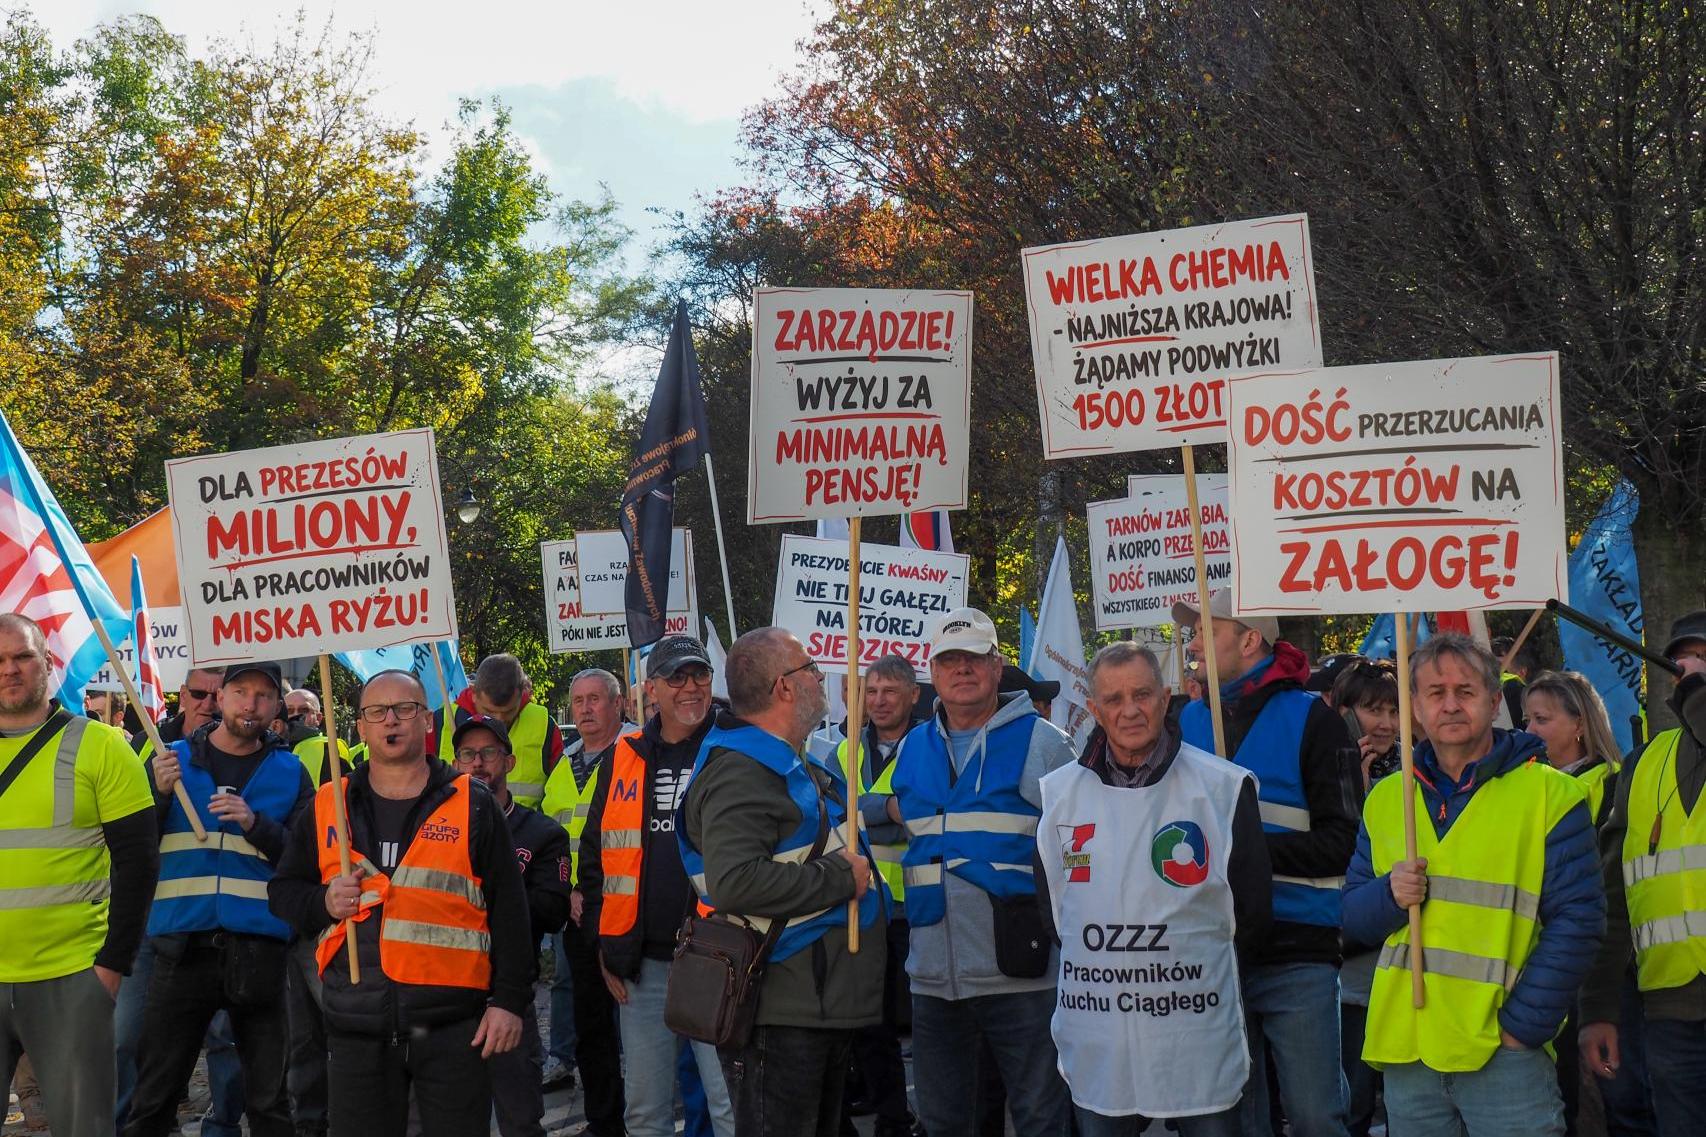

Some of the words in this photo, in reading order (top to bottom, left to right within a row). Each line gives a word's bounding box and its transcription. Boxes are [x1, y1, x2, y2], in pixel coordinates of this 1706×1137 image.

[1046, 256, 1162, 305] WIELKA
[1169, 241, 1290, 292] CHEMIA
[775, 309, 954, 363] ZARZĄDZIE!
[1067, 303, 1180, 343] NAJNIŻSZA
[1184, 291, 1292, 330] KRAJOWA!
[1073, 351, 1161, 389] ŻĄDAMY
[1169, 332, 1280, 375] PODWYŻKI
[796, 367, 889, 411] WYŻYJ
[897, 375, 932, 409] ZA
[1072, 388, 1145, 431] 1500
[1154, 379, 1225, 422] ZŁOT
[1245, 387, 1352, 446] DOŚĆ
[1358, 403, 1544, 438] PRZERZUCANIA
[776, 424, 947, 465] MINIMALNĄ
[198, 471, 253, 503] DLA
[259, 447, 407, 497] PREZESÓW
[805, 463, 921, 507] PENSJĘ!
[1274, 455, 1459, 511] KOSZTÓW
[1472, 468, 1520, 501] NA
[207, 490, 417, 560] MILIONY,
[1106, 507, 1163, 537] TARNÓW
[1166, 503, 1229, 529] ZARBIA,
[1107, 544, 1116, 562] A
[1119, 538, 1160, 560] KORPO
[1279, 530, 1519, 600] ZAŁOGĘ!
[202, 578, 248, 604] DLA
[255, 552, 430, 598] PRACOWNIKÓW
[585, 574, 608, 582] CZAS
[611, 573, 625, 581] NA
[796, 579, 828, 598] NIE
[887, 563, 949, 584] KWAŚNY
[1108, 564, 1145, 593] DOŚĆ
[1148, 561, 1231, 587] FINANSOANIA
[213, 603, 322, 646] MISKA
[329, 587, 428, 634] RYŻU!
[816, 609, 844, 629] NA
[859, 611, 923, 638] TÓREJ
[1102, 597, 1160, 614] WSZYSTKIEGO
[1170, 592, 1200, 606] NASZE
[562, 624, 584, 641] PÓKI
[586, 626, 602, 639] NIE
[605, 624, 626, 638] JEST
[613, 779, 637, 801] NA
[1083, 923, 1169, 952] OZZZ
[1063, 960, 1203, 983] Pracowników
[1117, 990, 1220, 1016] Ciągłego
